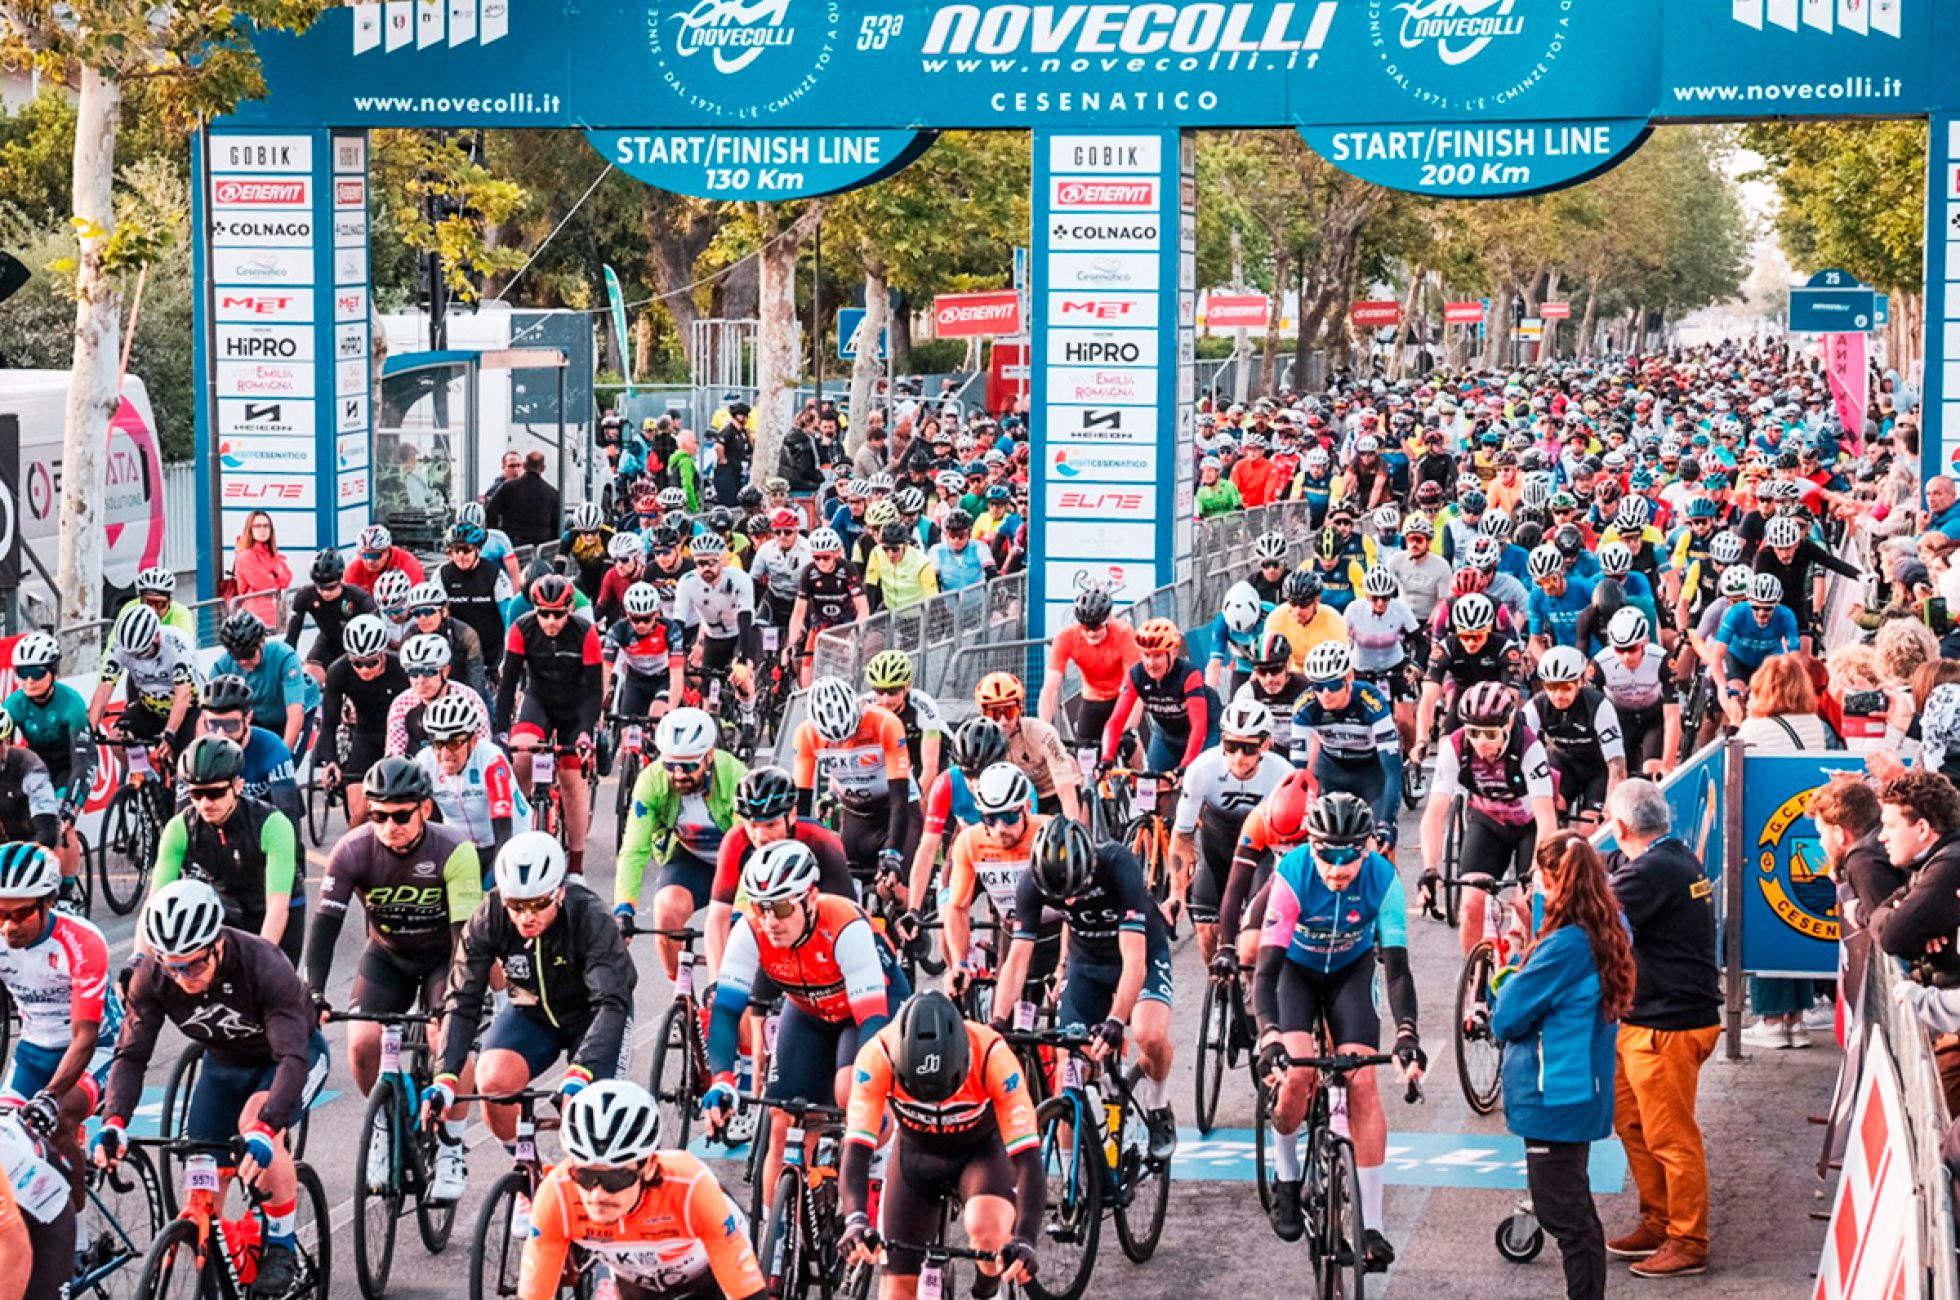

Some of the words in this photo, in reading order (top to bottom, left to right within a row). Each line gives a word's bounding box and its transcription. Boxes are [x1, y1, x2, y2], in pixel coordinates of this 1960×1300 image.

[647, 8, 660, 55] SINCE
[691, 27, 795, 47] NOVECOLLI
[920, 1, 1338, 54] NOVECOLLI
[1414, 16, 1525, 38] NOVECOLLI
[920, 51, 1321, 74] www.novecolli.it
[1386, 64, 1410, 90] DAL
[1413, 87, 1448, 109] 1971
[1545, 32, 1566, 60] TOT
[663, 71, 687, 97] DAL
[689, 95, 722, 116] 1971
[814, 43, 834, 71] TOT
[1673, 76, 1903, 102] www.novecolli.it
[354, 93, 560, 115] www.novecolli.it
[991, 91, 1219, 112] CESENATICO
[616, 134, 808, 167] START/FINISH
[818, 136, 881, 164] LINE
[1332, 127, 1535, 162] START/FINISH
[1544, 125, 1611, 155] LINE
[229, 146, 291, 166] GOBIK
[1074, 146, 1138, 166] GOBIK
[705, 169, 750, 191] 130
[757, 169, 805, 191] Km
[1419, 163, 1477, 187] 200
[1482, 162, 1530, 186] Km
[241, 184, 302, 201] ENERVIT
[1085, 185, 1150, 202] ENERVIT
[230, 223, 310, 236] COLNAGO
[1072, 226, 1158, 239] COLNAGO
[222, 296, 294, 314] MET
[960, 303, 1015, 322] ENERVIT
[1062, 301, 1138, 319] MET
[227, 337, 297, 357] HiPRO
[1066, 342, 1140, 362] HiPRO
[224, 483, 304, 498] ELITE
[1059, 493, 1143, 509] ELITE
[1777, 900, 1838, 937] CESEN
